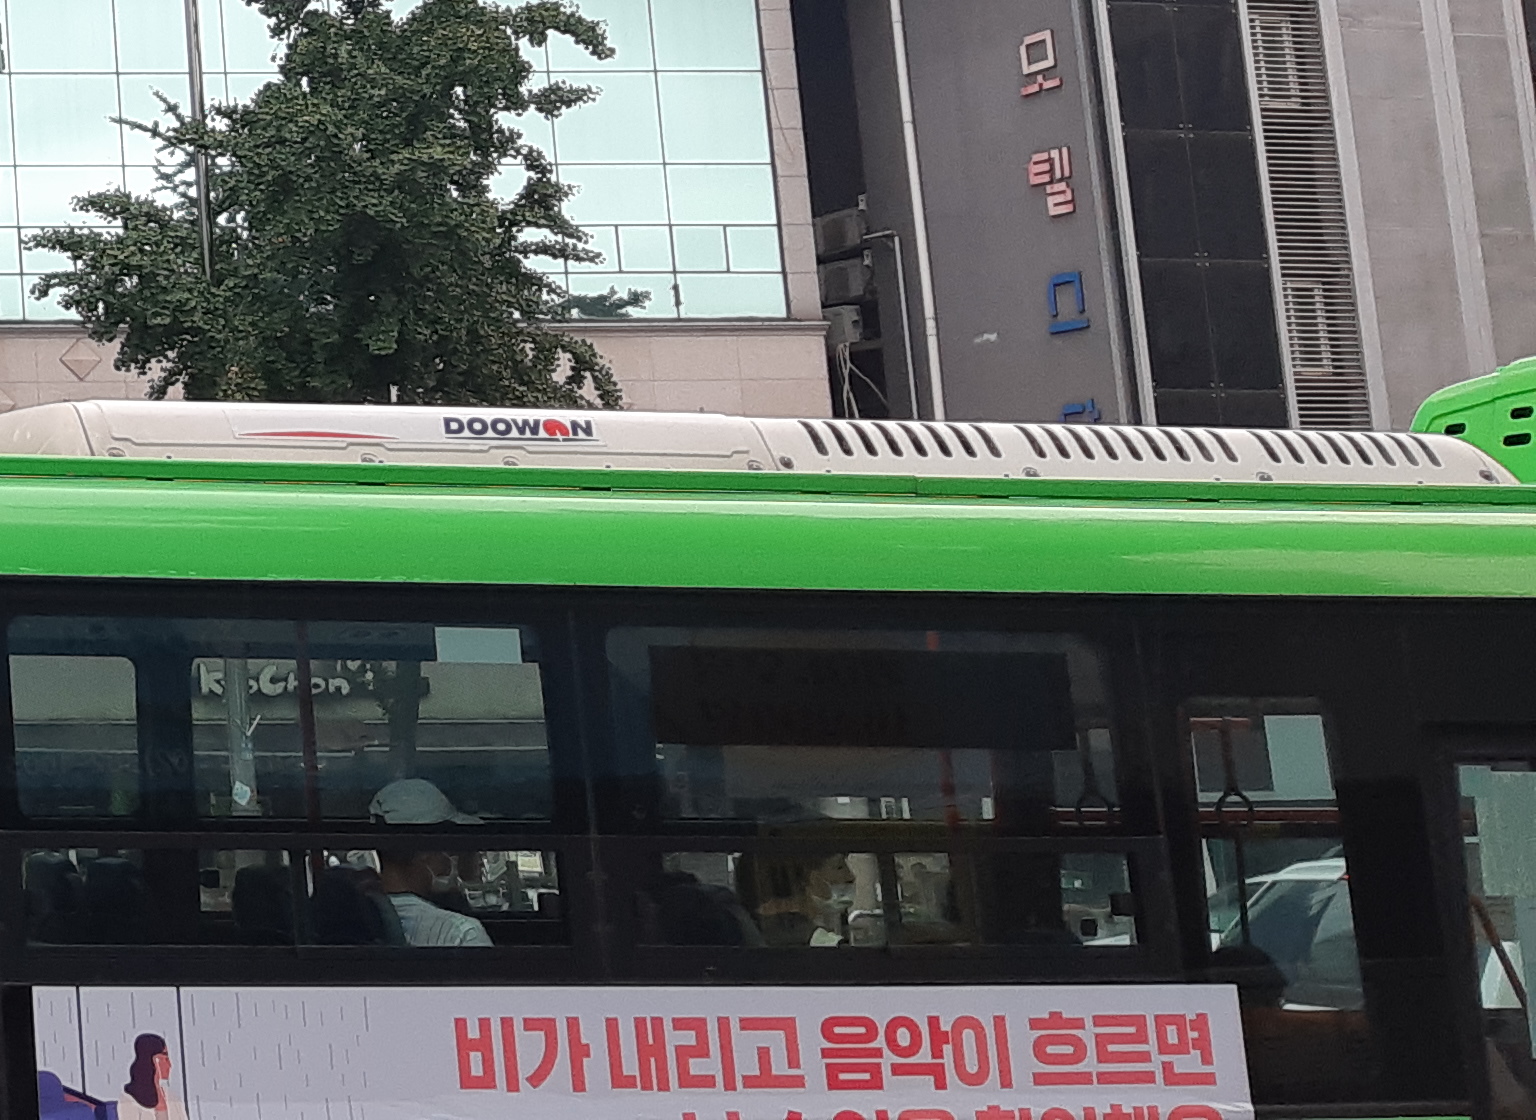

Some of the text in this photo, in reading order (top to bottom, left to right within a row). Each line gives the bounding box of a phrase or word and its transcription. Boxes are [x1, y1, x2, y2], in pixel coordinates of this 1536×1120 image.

[453, 1010, 1218, 1093] 비가 내리고 음악이 흐르면
